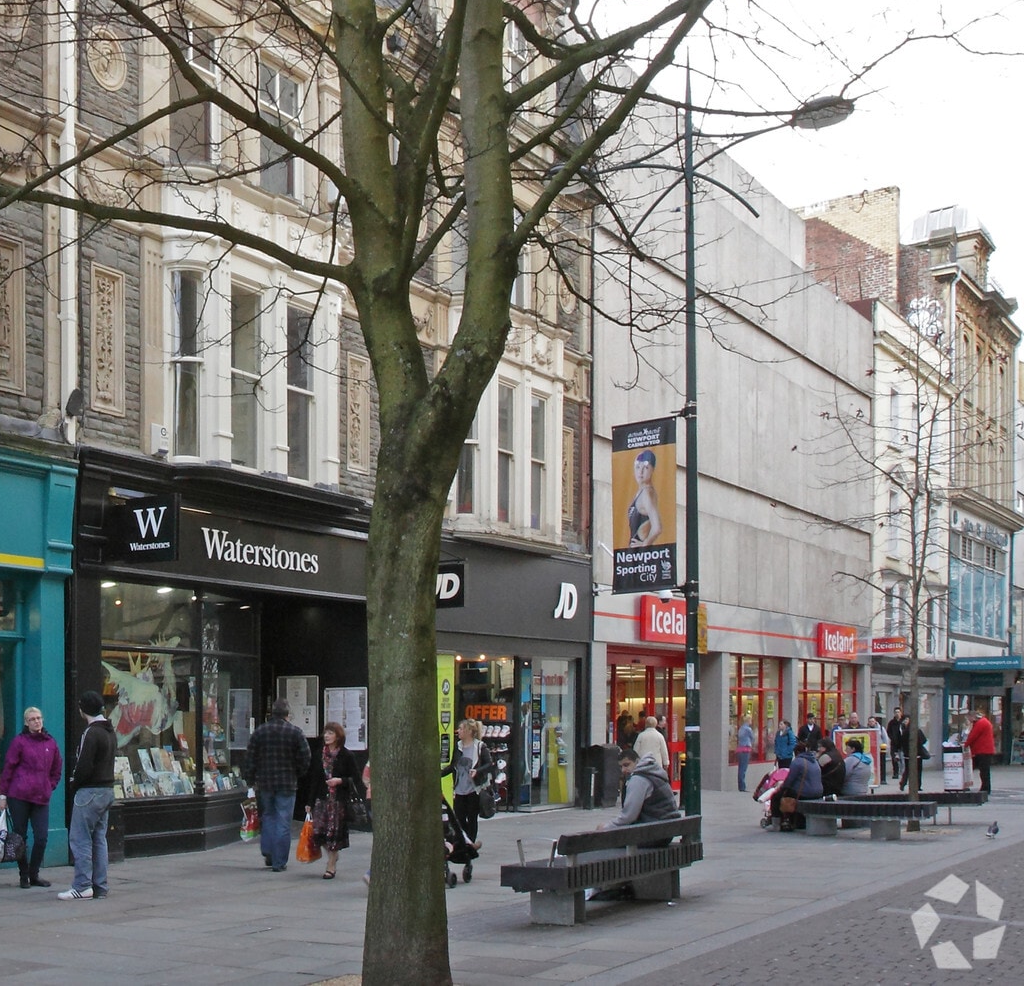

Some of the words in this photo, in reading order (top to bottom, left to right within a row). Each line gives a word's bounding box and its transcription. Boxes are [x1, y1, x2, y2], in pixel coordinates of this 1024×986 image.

[627, 433, 660, 444] NEWPORT
[133, 506, 168, 539] W
[129, 541, 171, 552] Waterstones
[201, 527, 319, 574] Waterstones
[616, 547, 670, 564] Newport
[616, 563, 657, 577] Sporting
[639, 571, 658, 583] City
[553, 582, 578, 620] JD
[651, 604, 687, 636] Icela
[825, 629, 854, 654] Iceland
[465, 704, 507, 721] OFFER
